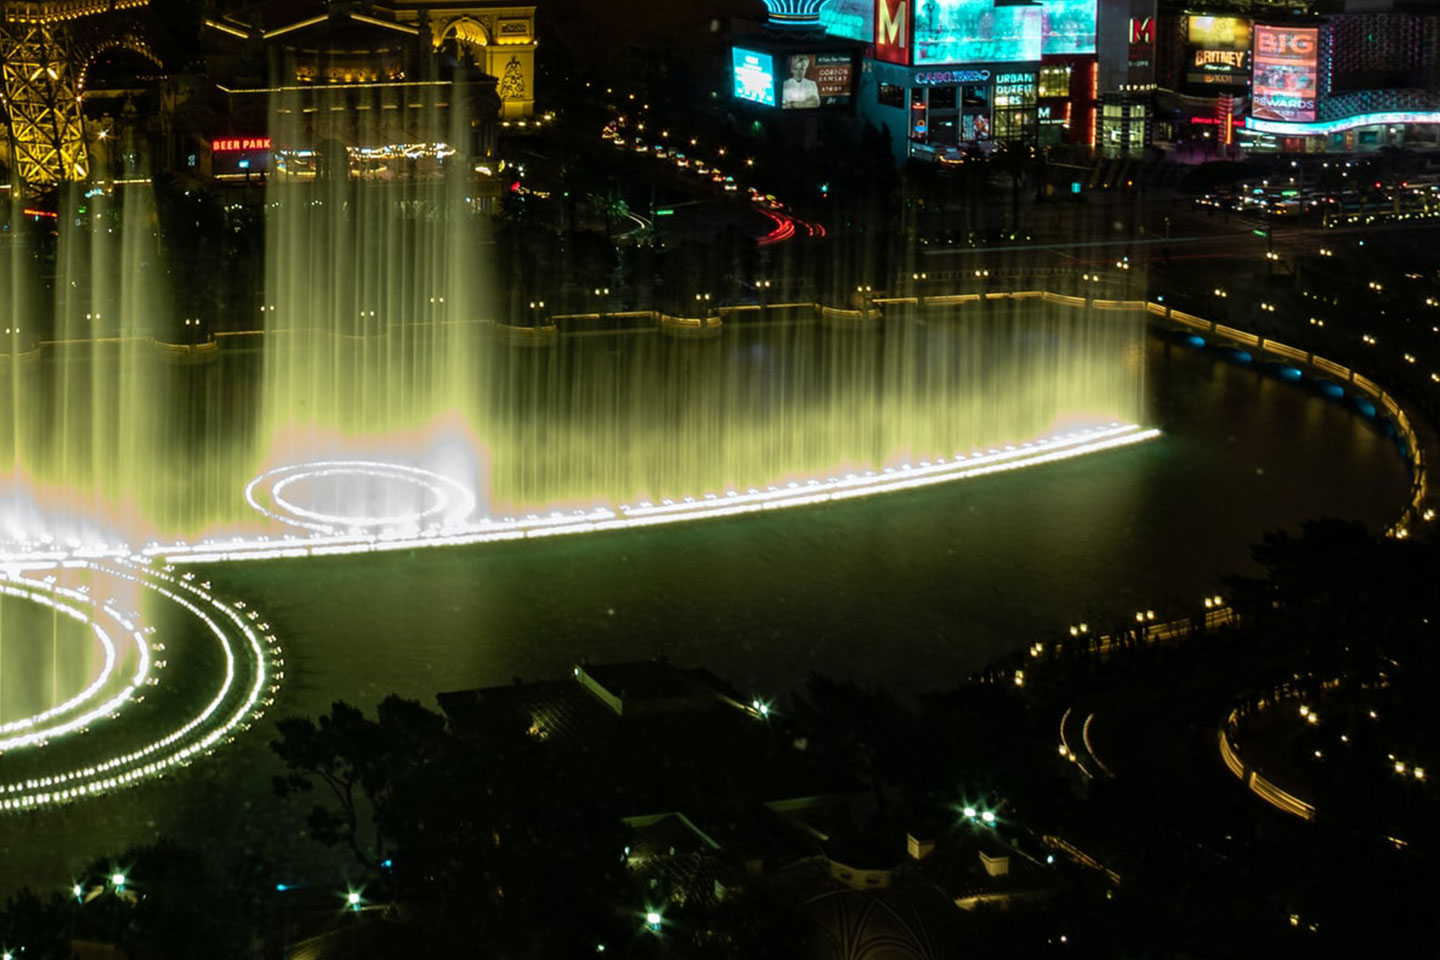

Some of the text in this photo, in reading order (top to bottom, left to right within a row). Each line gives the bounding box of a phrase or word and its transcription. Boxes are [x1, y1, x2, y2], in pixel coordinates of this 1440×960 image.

[1260, 32, 1314, 54] BIG
[1195, 50, 1244, 67] BRITNEY
[996, 74, 1033, 84] URBAN
[1254, 94, 1315, 110] REWARDS
[212, 138, 271, 151] BEER PARK
